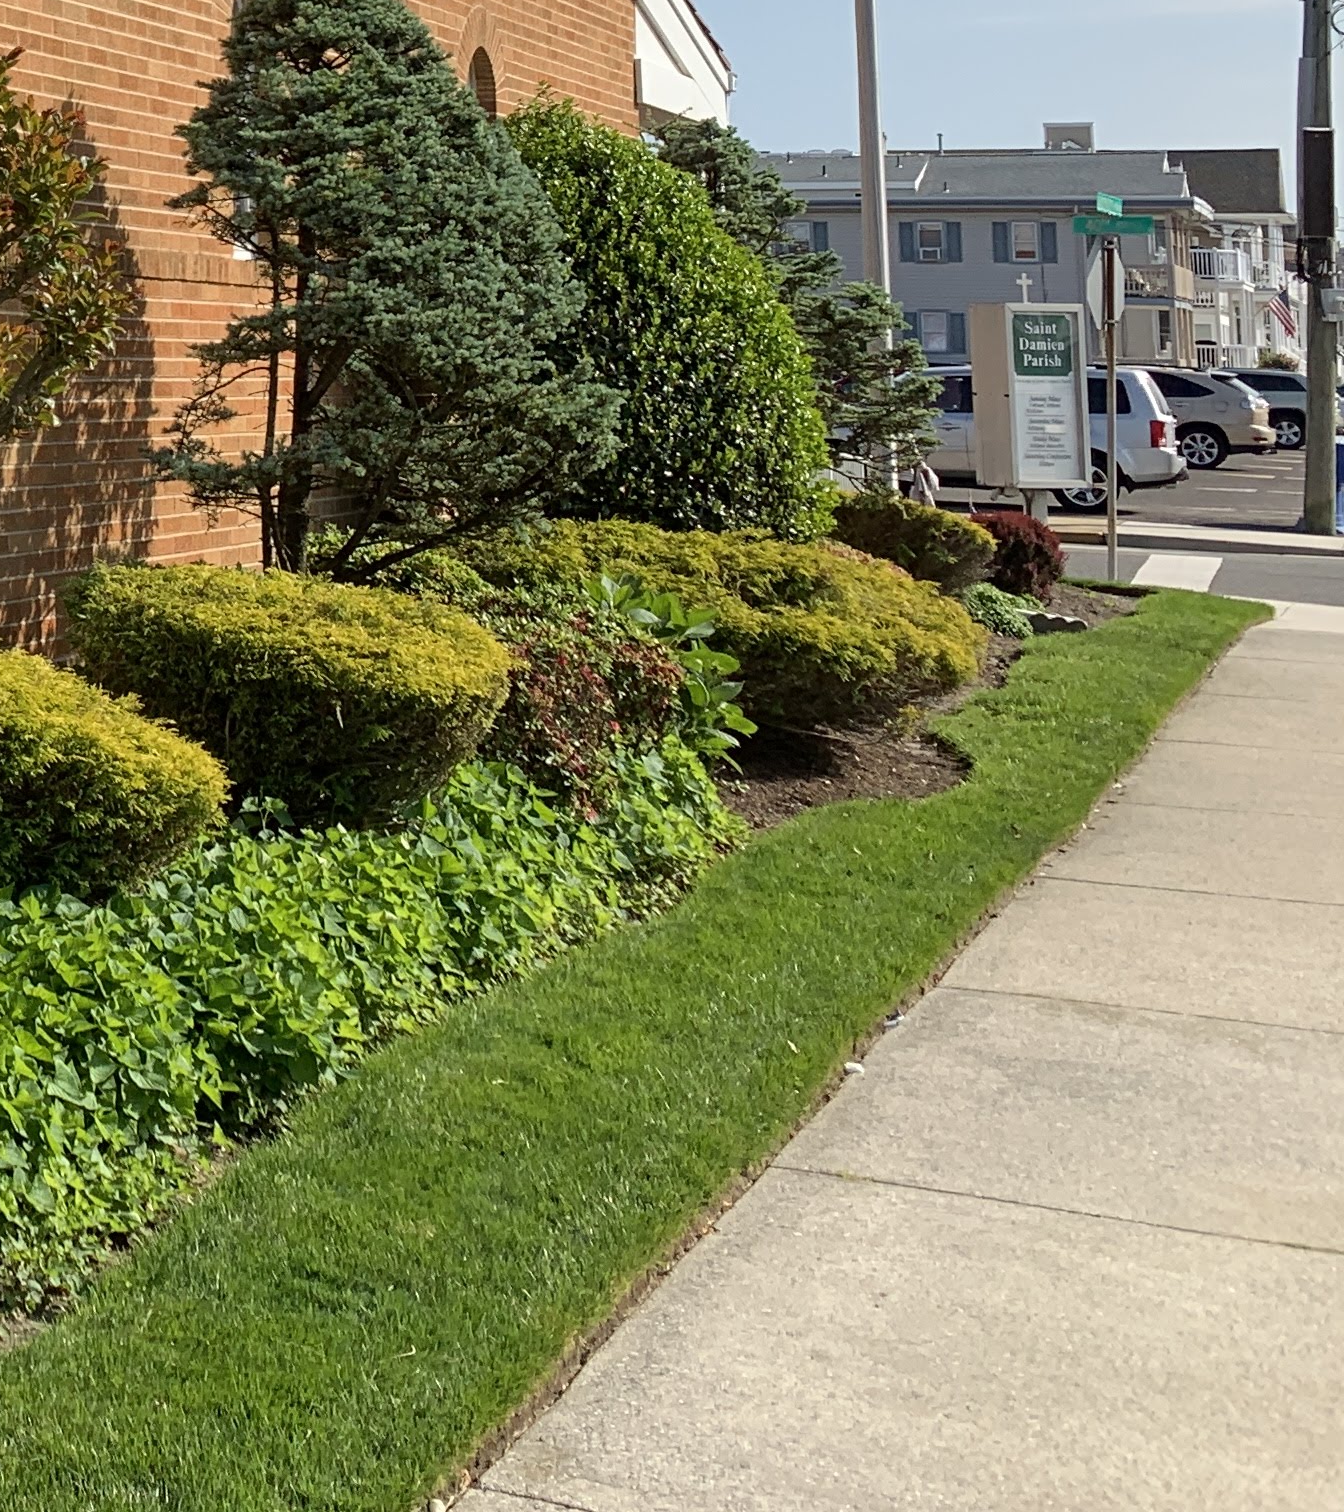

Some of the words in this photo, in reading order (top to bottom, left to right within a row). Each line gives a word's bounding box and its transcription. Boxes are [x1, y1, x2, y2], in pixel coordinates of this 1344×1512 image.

[1024, 321, 1057, 335] Saint
[1019, 337, 1065, 352] Damien
[1023, 353, 1062, 369] Parish
